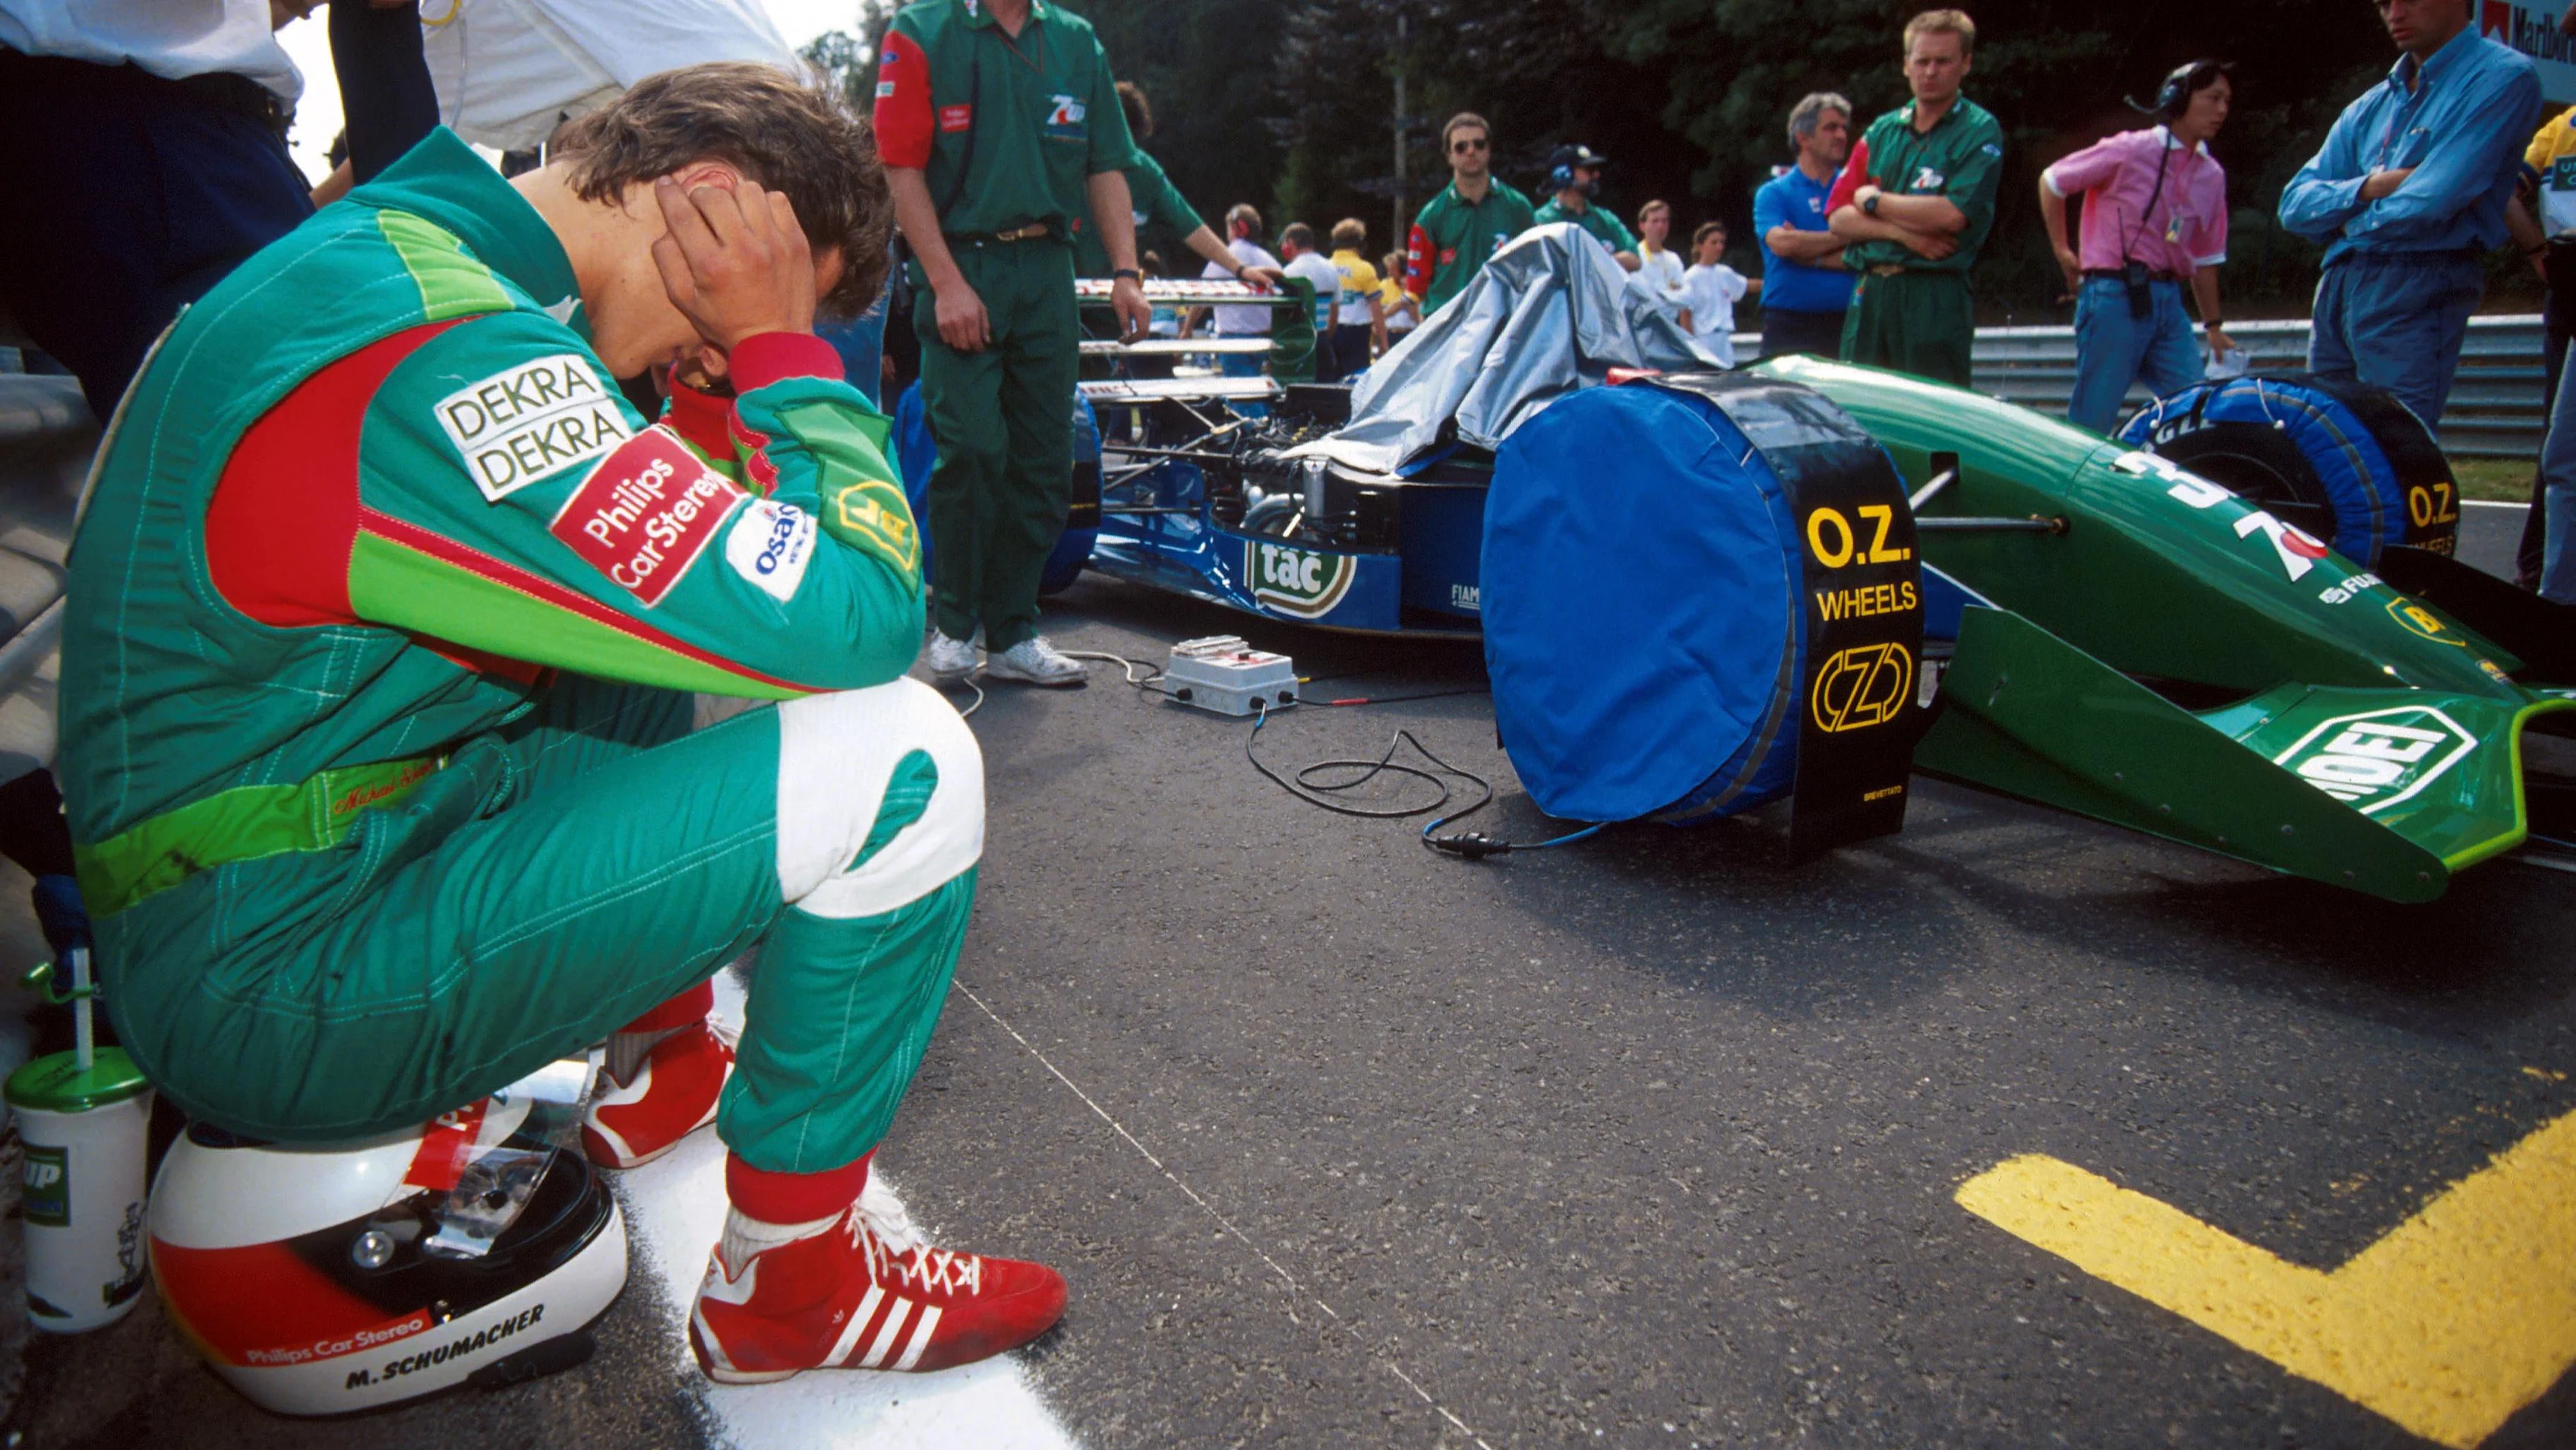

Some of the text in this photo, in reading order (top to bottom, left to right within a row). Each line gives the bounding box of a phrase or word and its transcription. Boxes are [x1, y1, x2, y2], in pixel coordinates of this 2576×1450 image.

[2513, 5, 2576, 65] Marlbor
[446, 361, 597, 441] DEKRA
[476, 407, 626, 490] DEKRA
[583, 458, 674, 548] Philips
[1261, 542, 1322, 594] tac
[1806, 504, 1911, 569] O.Z.
[1816, 580, 1918, 622] WHEELS
[246, 1317, 425, 1366] Philips Car Stereo
[345, 1303, 545, 1391] M. SCHUMACHER
